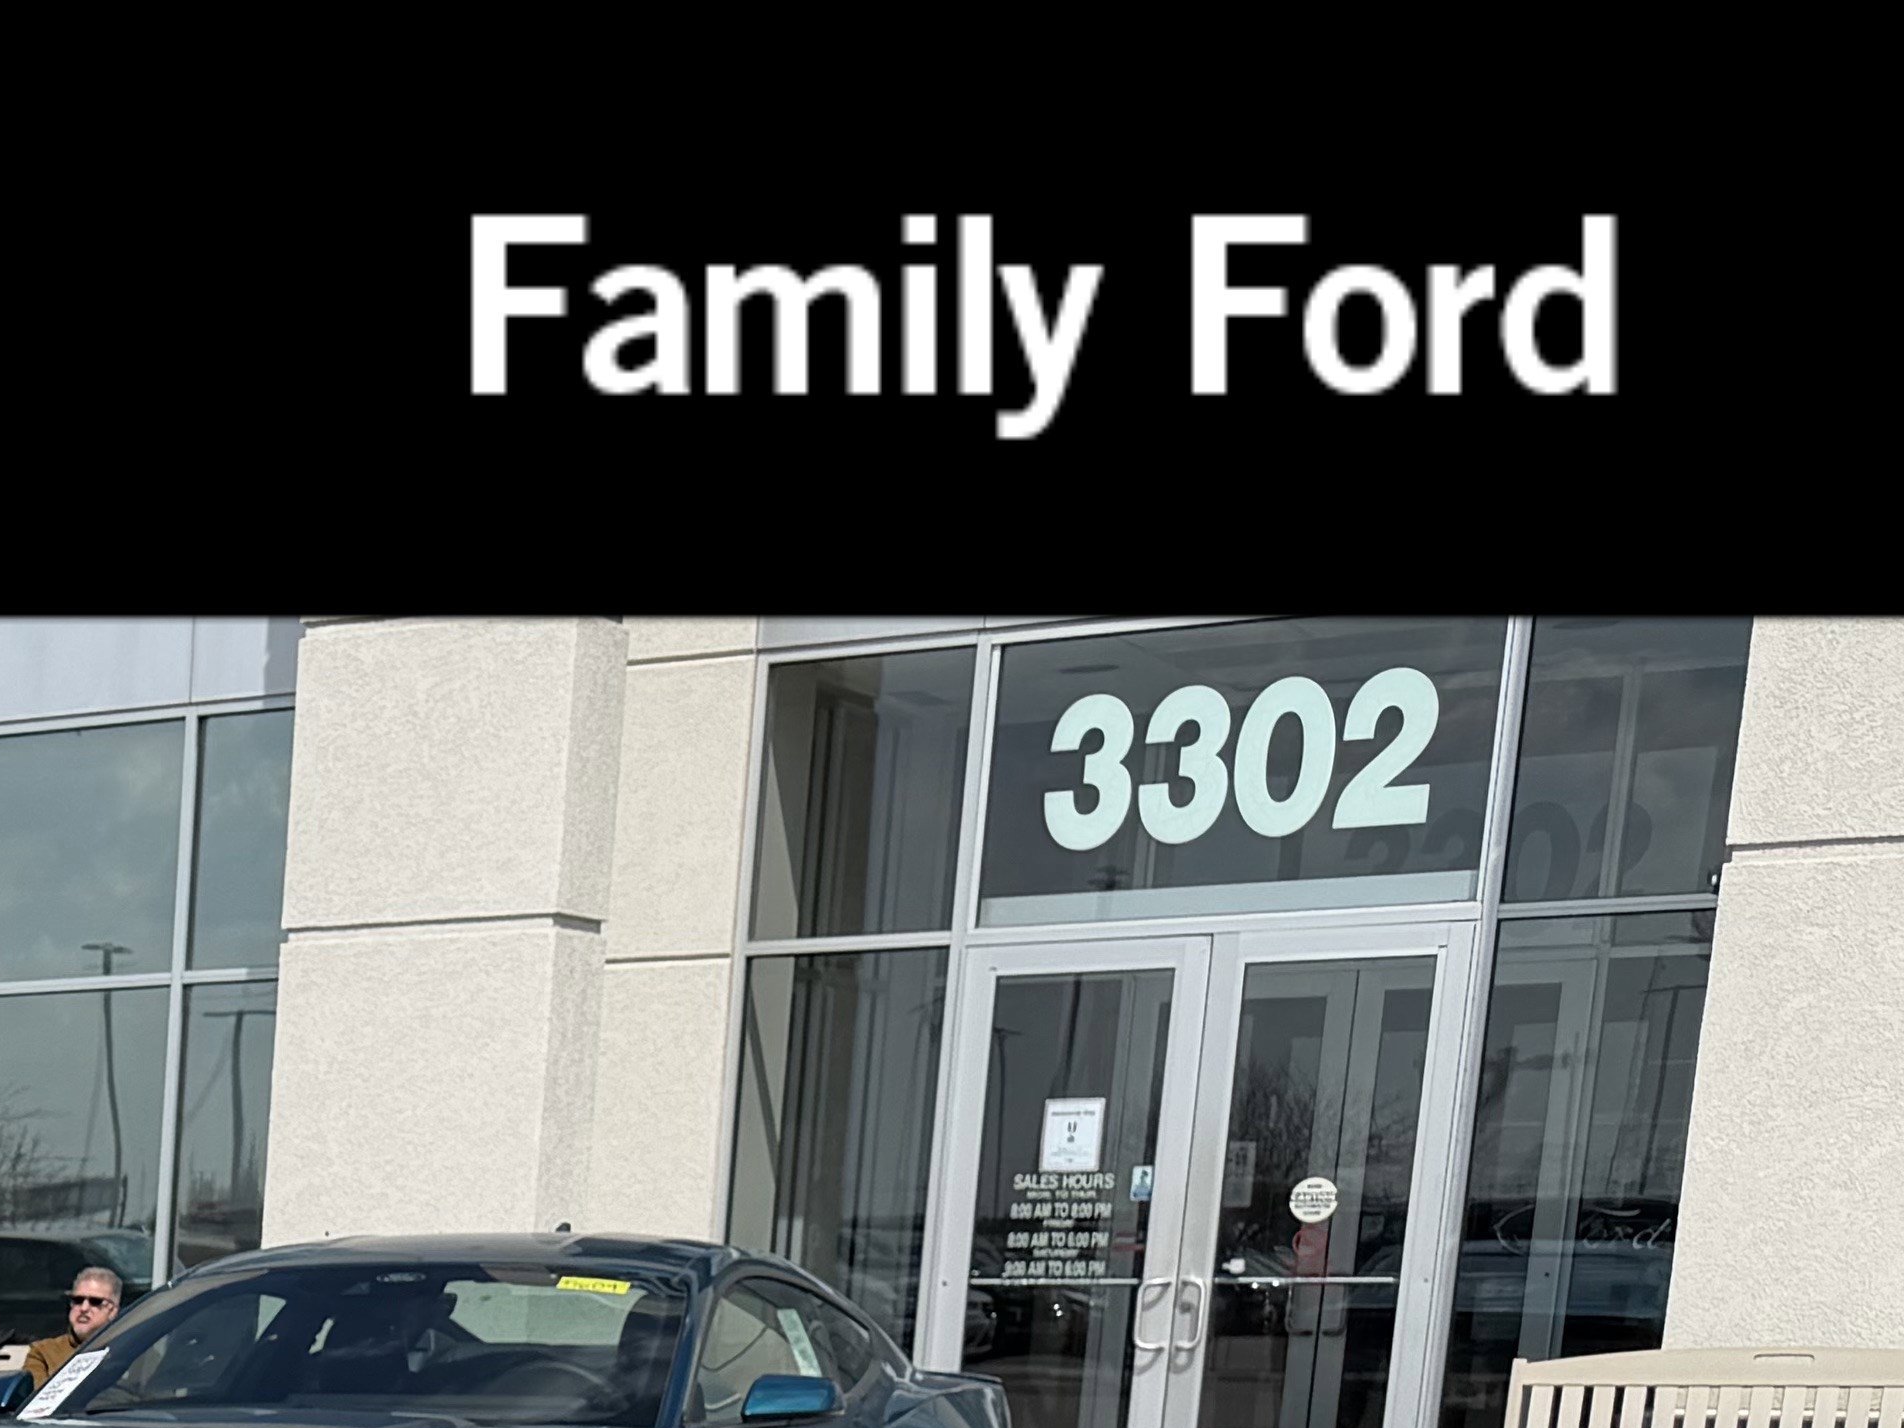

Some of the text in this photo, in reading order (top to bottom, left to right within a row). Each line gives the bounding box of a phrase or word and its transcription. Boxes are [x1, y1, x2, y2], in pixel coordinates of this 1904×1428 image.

[1044, 667, 1439, 850] 3302
[1013, 1172, 1115, 1190] SALES HOURS
[1034, 1202, 1052, 1219] AM
[1053, 1202, 1069, 1218] TO
[1094, 1202, 1112, 1219] PM
[1030, 1231, 1049, 1248] AM
[1051, 1231, 1066, 1247] TO
[1091, 1231, 1109, 1248] PM
[1028, 1260, 1046, 1276] AM
[1048, 1260, 1063, 1276] TO
[1088, 1260, 1106, 1276] PM
